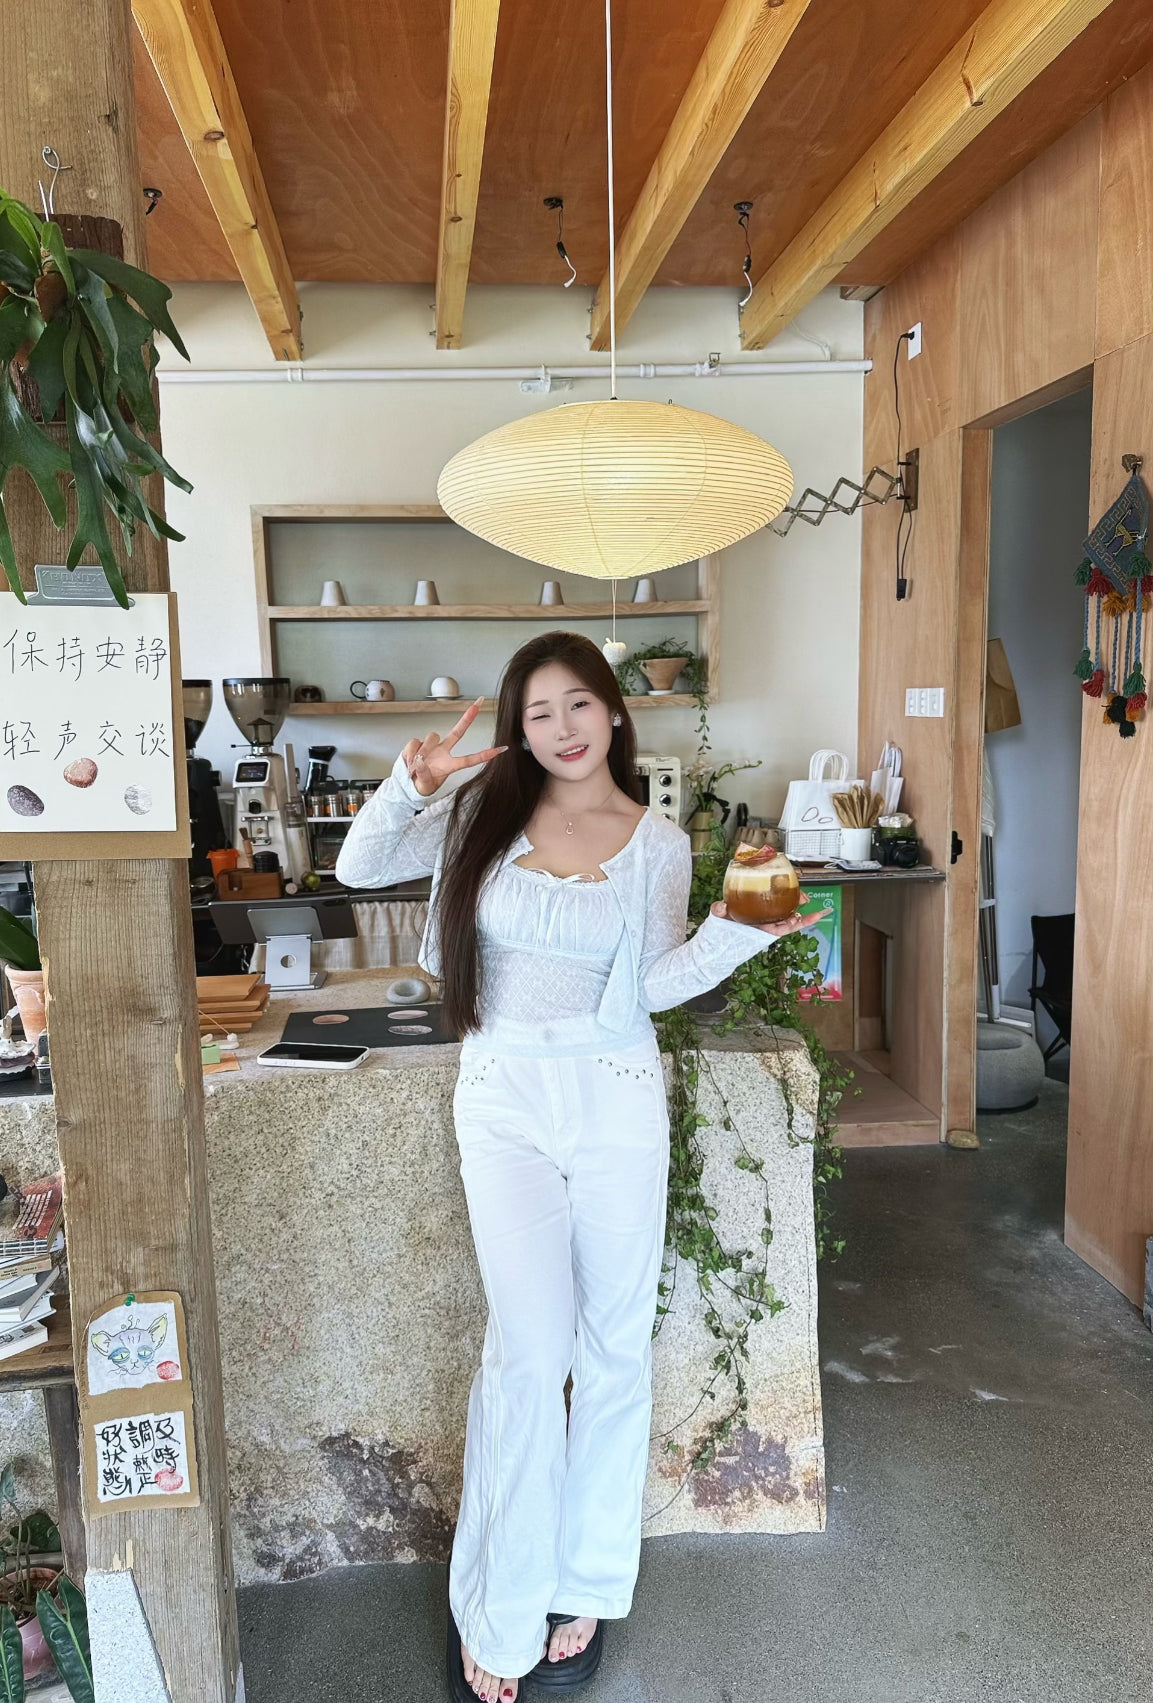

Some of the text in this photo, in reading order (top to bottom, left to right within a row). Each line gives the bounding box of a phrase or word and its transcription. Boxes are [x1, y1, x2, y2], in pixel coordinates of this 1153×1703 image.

[3, 629, 168, 682] 保持安静
[2, 720, 171, 761] 轻声交谈
